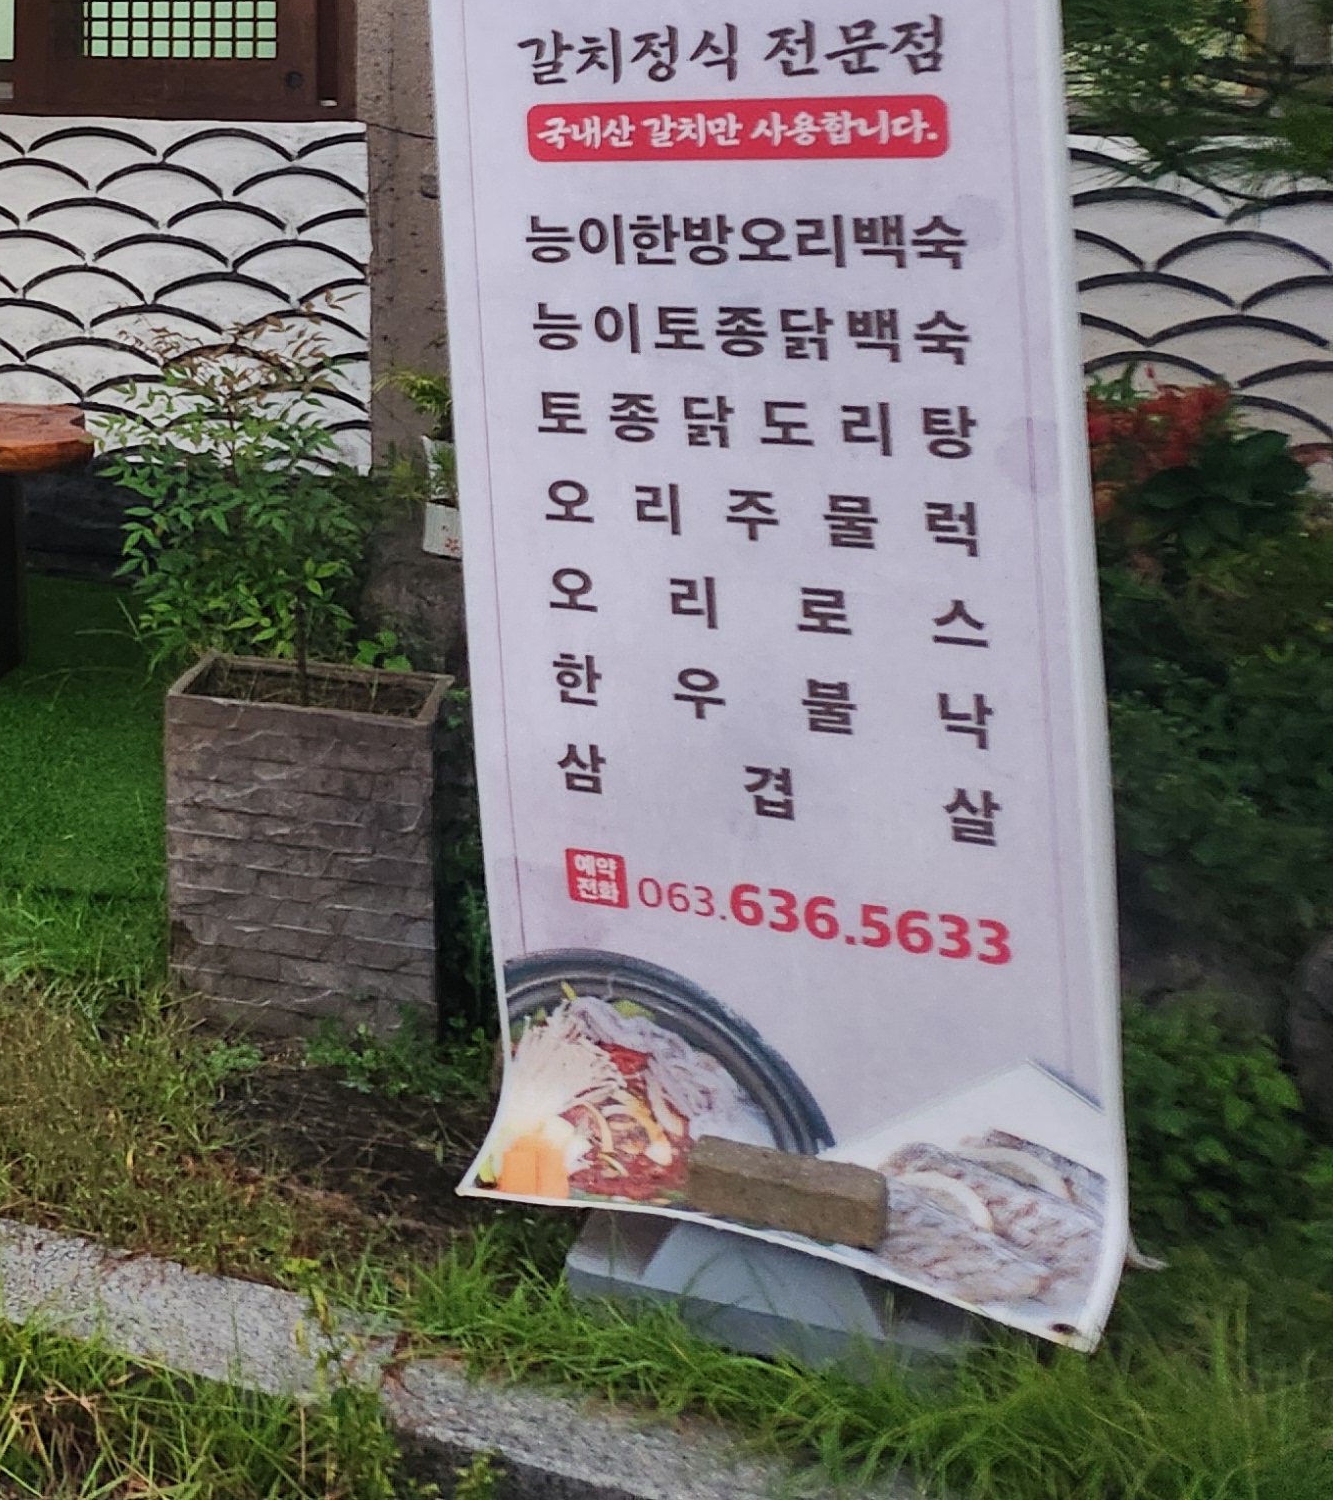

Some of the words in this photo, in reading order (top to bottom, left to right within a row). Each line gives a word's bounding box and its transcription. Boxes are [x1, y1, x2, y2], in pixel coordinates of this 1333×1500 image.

[517, 21, 740, 85] 갈치정식
[763, 14, 944, 77] 전문점
[536, 113, 635, 152] 국내산
[641, 113, 742, 149] 갈치만
[749, 109, 939, 147] 사용합니다.
[525, 214, 968, 269] 능이한방오리백숙
[532, 303, 972, 365] 능이토종닭백숙
[574, 854, 618, 879] 예약
[576, 877, 620, 903] 전화
[637, 877, 1012, 965] 063.636.5633
